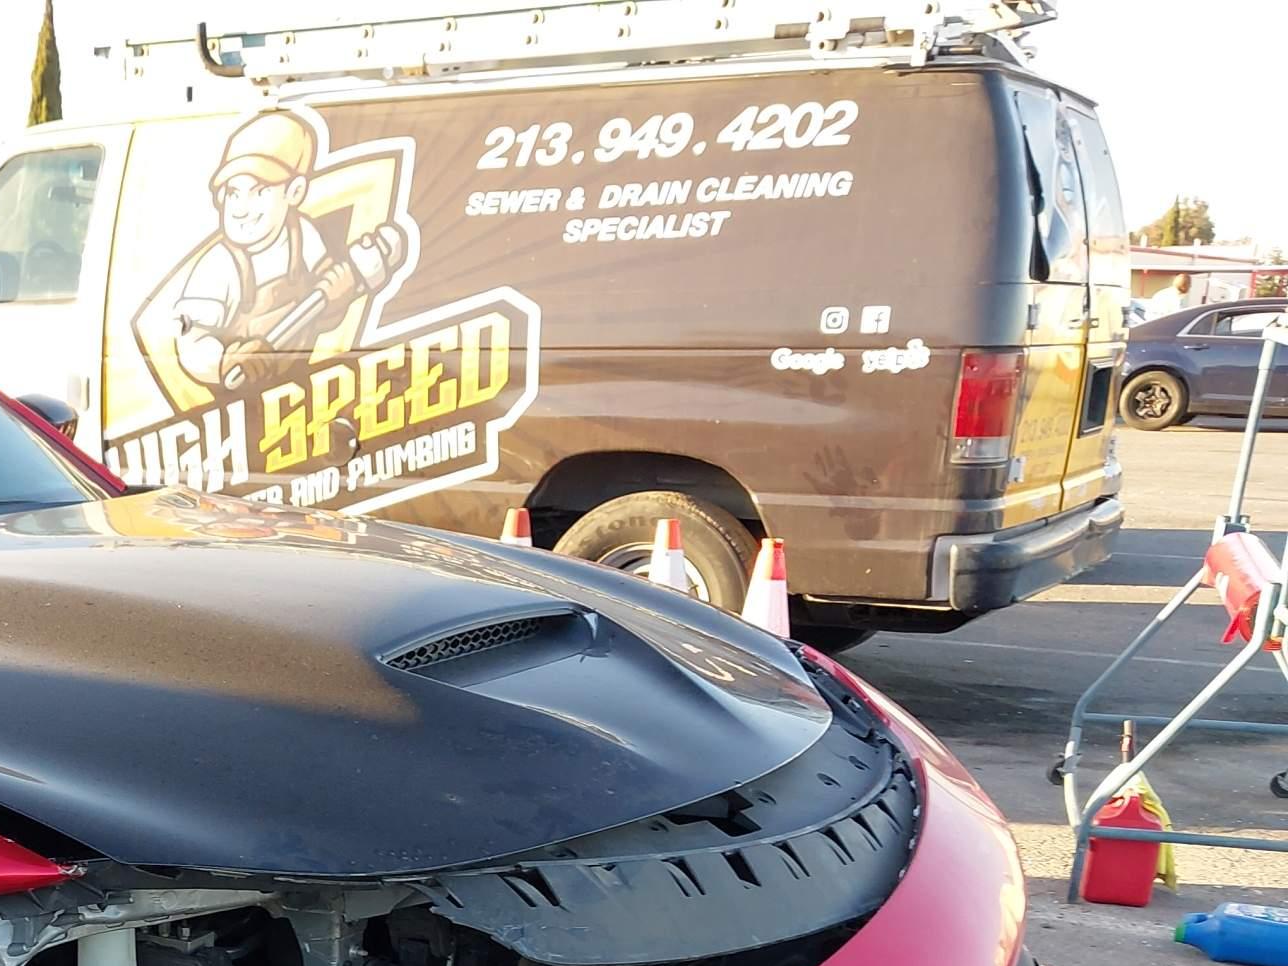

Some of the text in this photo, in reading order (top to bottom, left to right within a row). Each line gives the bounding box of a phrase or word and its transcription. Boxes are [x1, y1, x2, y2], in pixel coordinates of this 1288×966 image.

[476, 100, 859, 170] 213.949.4202
[465, 171, 854, 216] SEWER & DRAIN CLEANING
[563, 211, 731, 243] SPECIALIST
[259, 312, 510, 472] SPEED
[290, 421, 476, 507] AND PLUMBING
